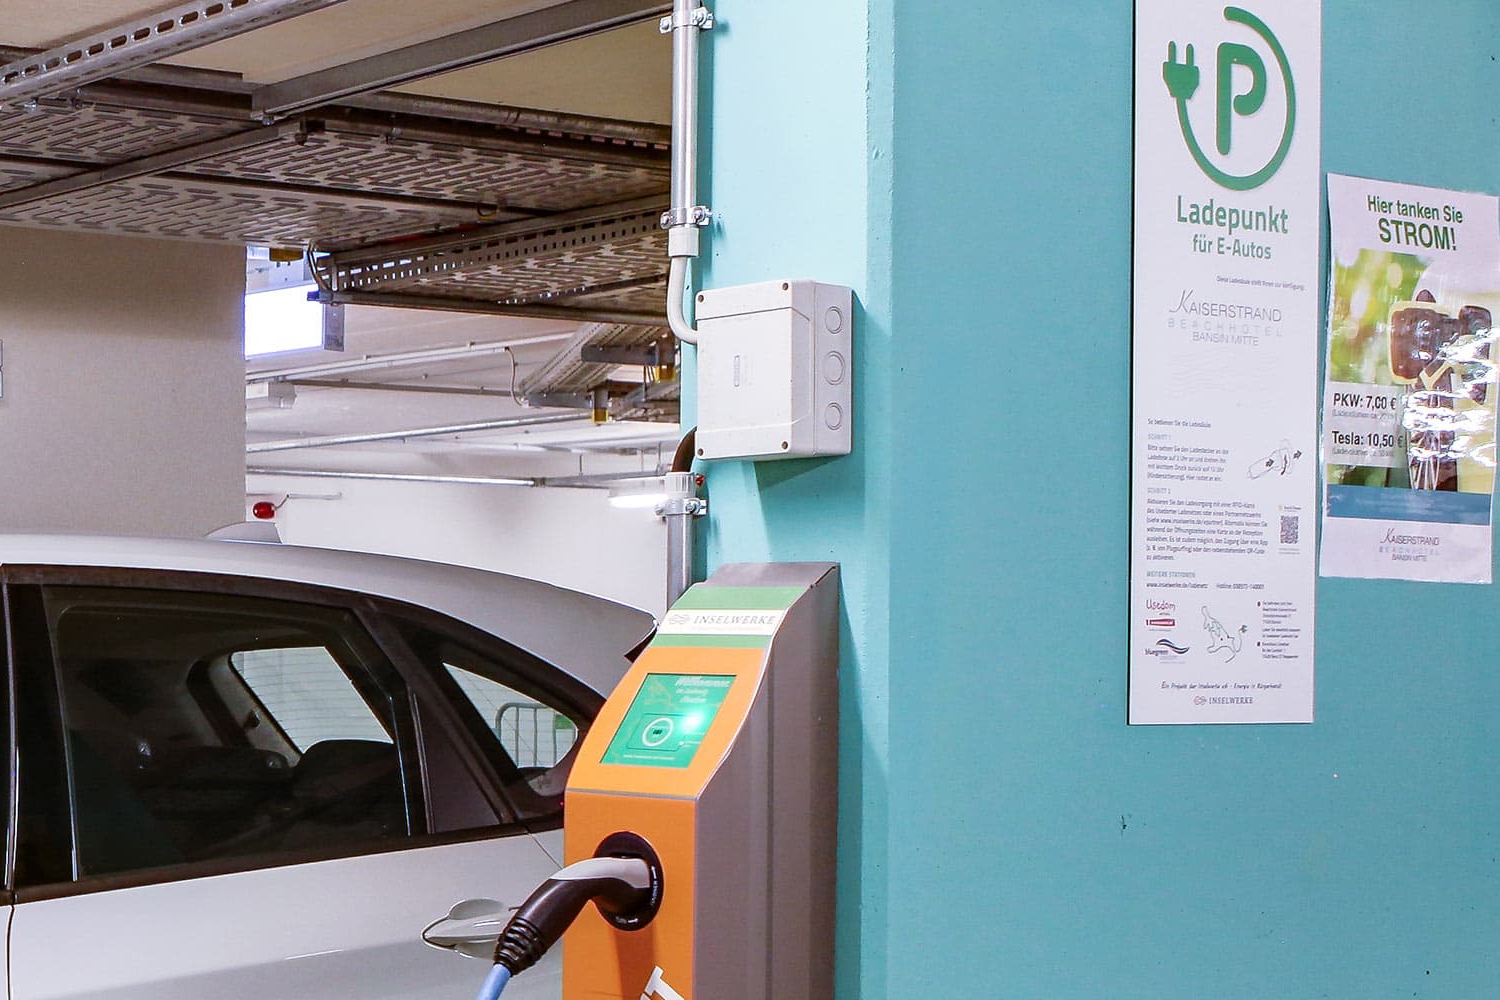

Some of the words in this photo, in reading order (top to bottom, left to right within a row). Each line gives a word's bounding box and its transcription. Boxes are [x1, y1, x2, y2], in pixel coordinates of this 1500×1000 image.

[1177, 195, 1289, 235] Ladepunkt
[1367, 195, 1393, 216] Hier
[1396, 198, 1440, 222] tanken
[1443, 204, 1463, 224] Sie
[1378, 217, 1457, 251] STROM!
[1193, 234, 1213, 254] für
[1217, 237, 1272, 260] E-Autos
[1333, 392, 1363, 408] PKW:
[1366, 395, 1388, 411] 7,00
[1390, 397, 1397, 410] €
[1332, 430, 1364, 445] Tesla:
[1367, 433, 1395, 449] 10,50
[1397, 435, 1404, 448] €
[1146, 599, 1176, 612] Usedom
[693, 614, 776, 625] INSELWERKE
[1208, 696, 1254, 705] INSELWERKE
